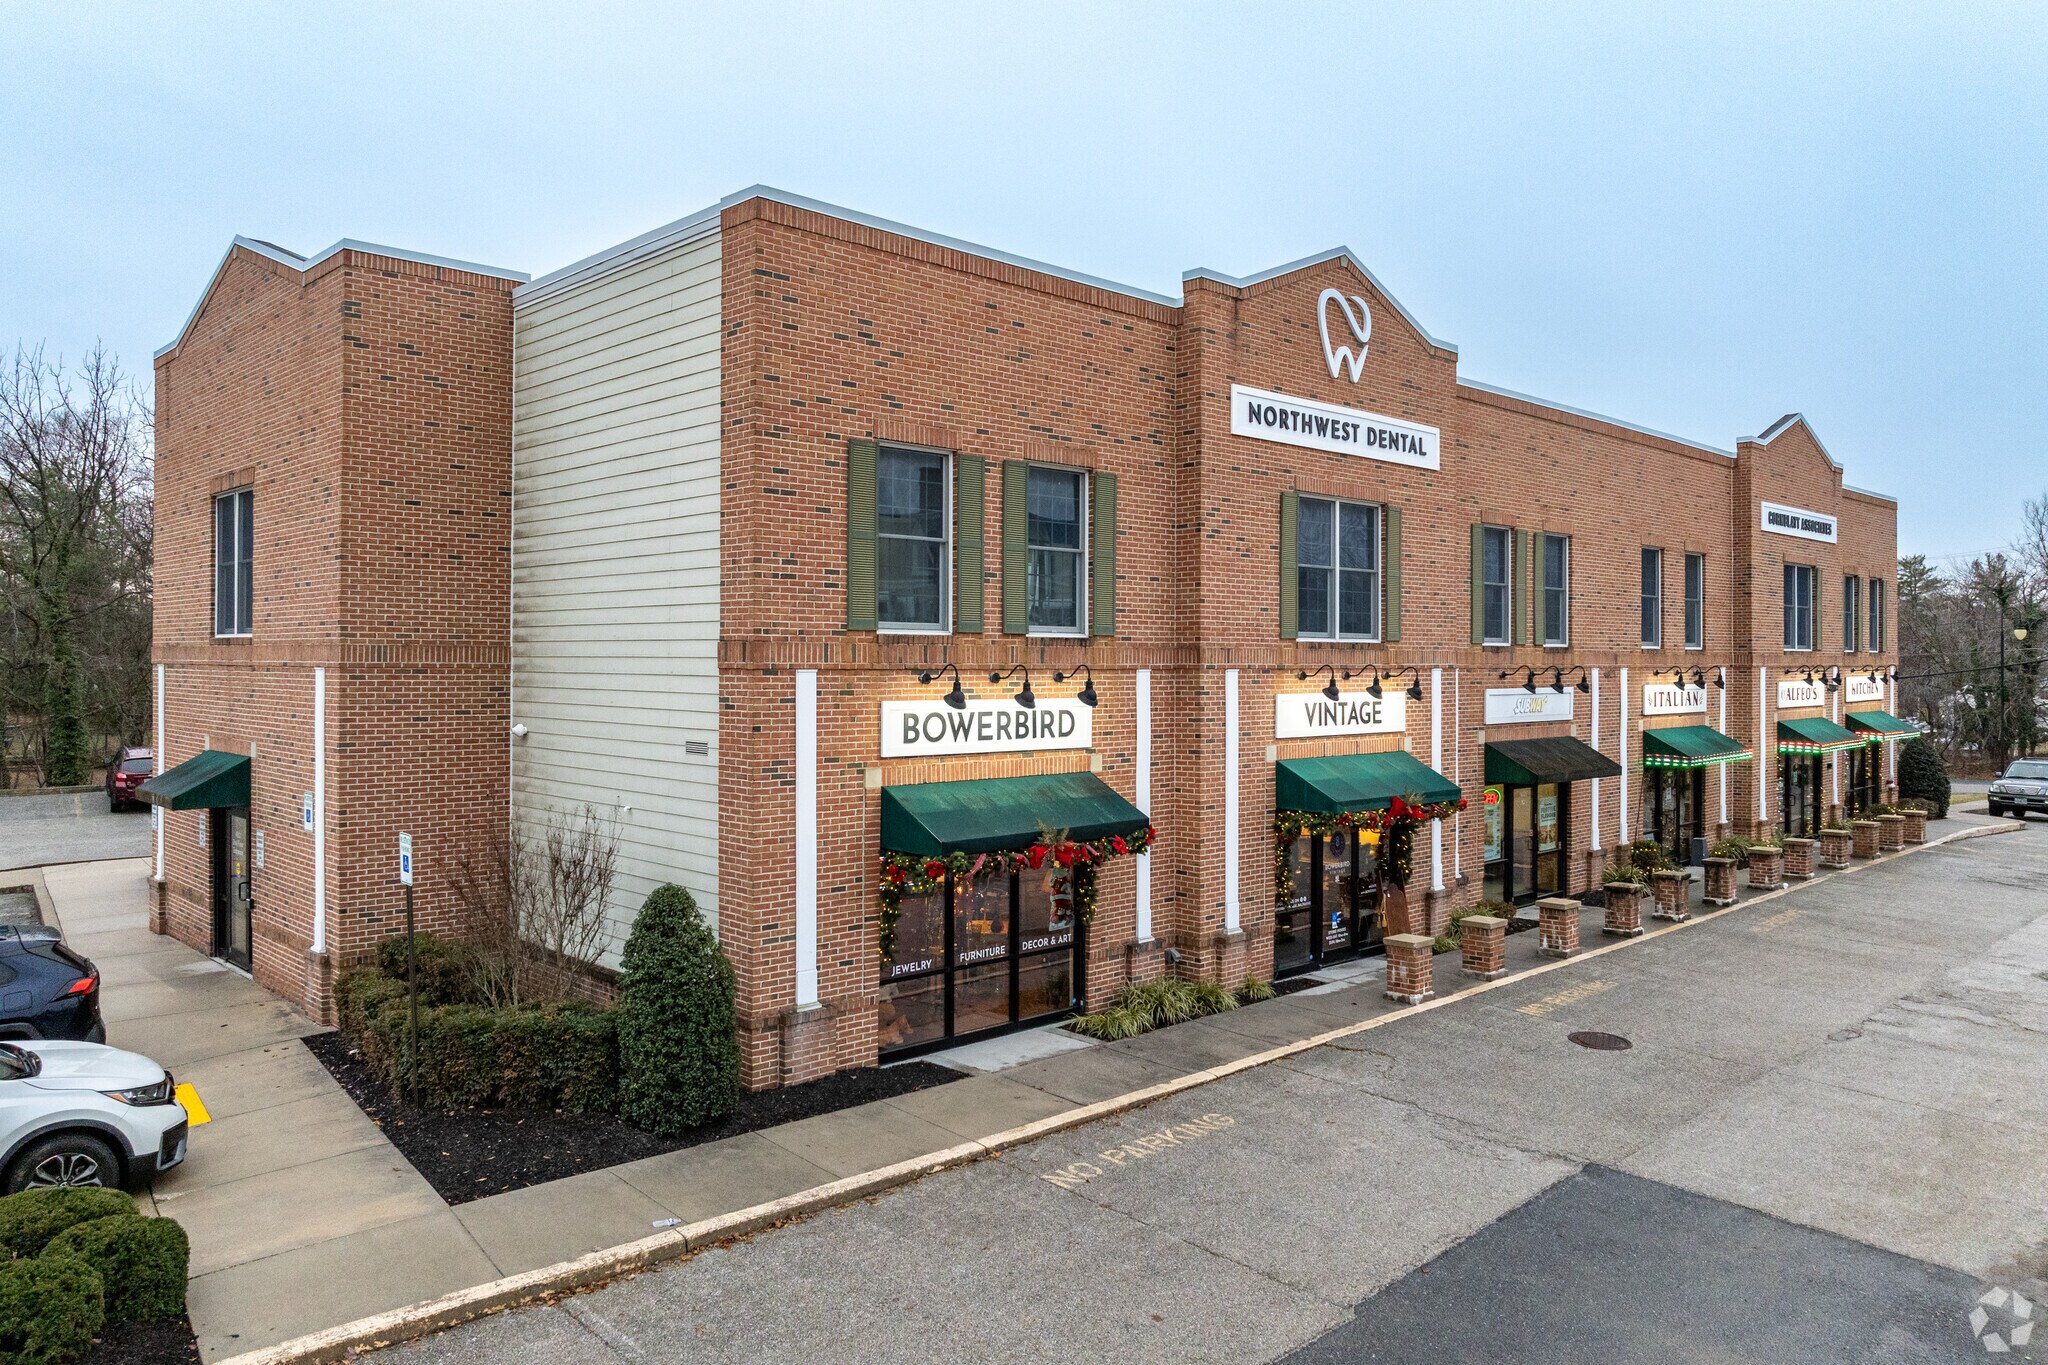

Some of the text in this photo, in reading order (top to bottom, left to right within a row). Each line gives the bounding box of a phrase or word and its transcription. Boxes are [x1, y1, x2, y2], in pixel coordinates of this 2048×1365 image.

[1248, 401, 1427, 457] NORTHWEST DENTAL
[1801, 518, 1832, 535] ASSOCIATES
[1653, 691, 1699, 708] ITALIAN
[1786, 687, 1818, 701] ALFEO'S
[1304, 700, 1383, 728] VINTAGE
[1513, 695, 1548, 715] SUBWAY
[903, 709, 1076, 744] BOWERBIRD
[1022, 933, 1073, 951] DECOR & ART
[959, 945, 1006, 962] FURNITURE
[891, 959, 933, 977] JEWELRY
[1039, 1113, 1235, 1189] NO PARKING
